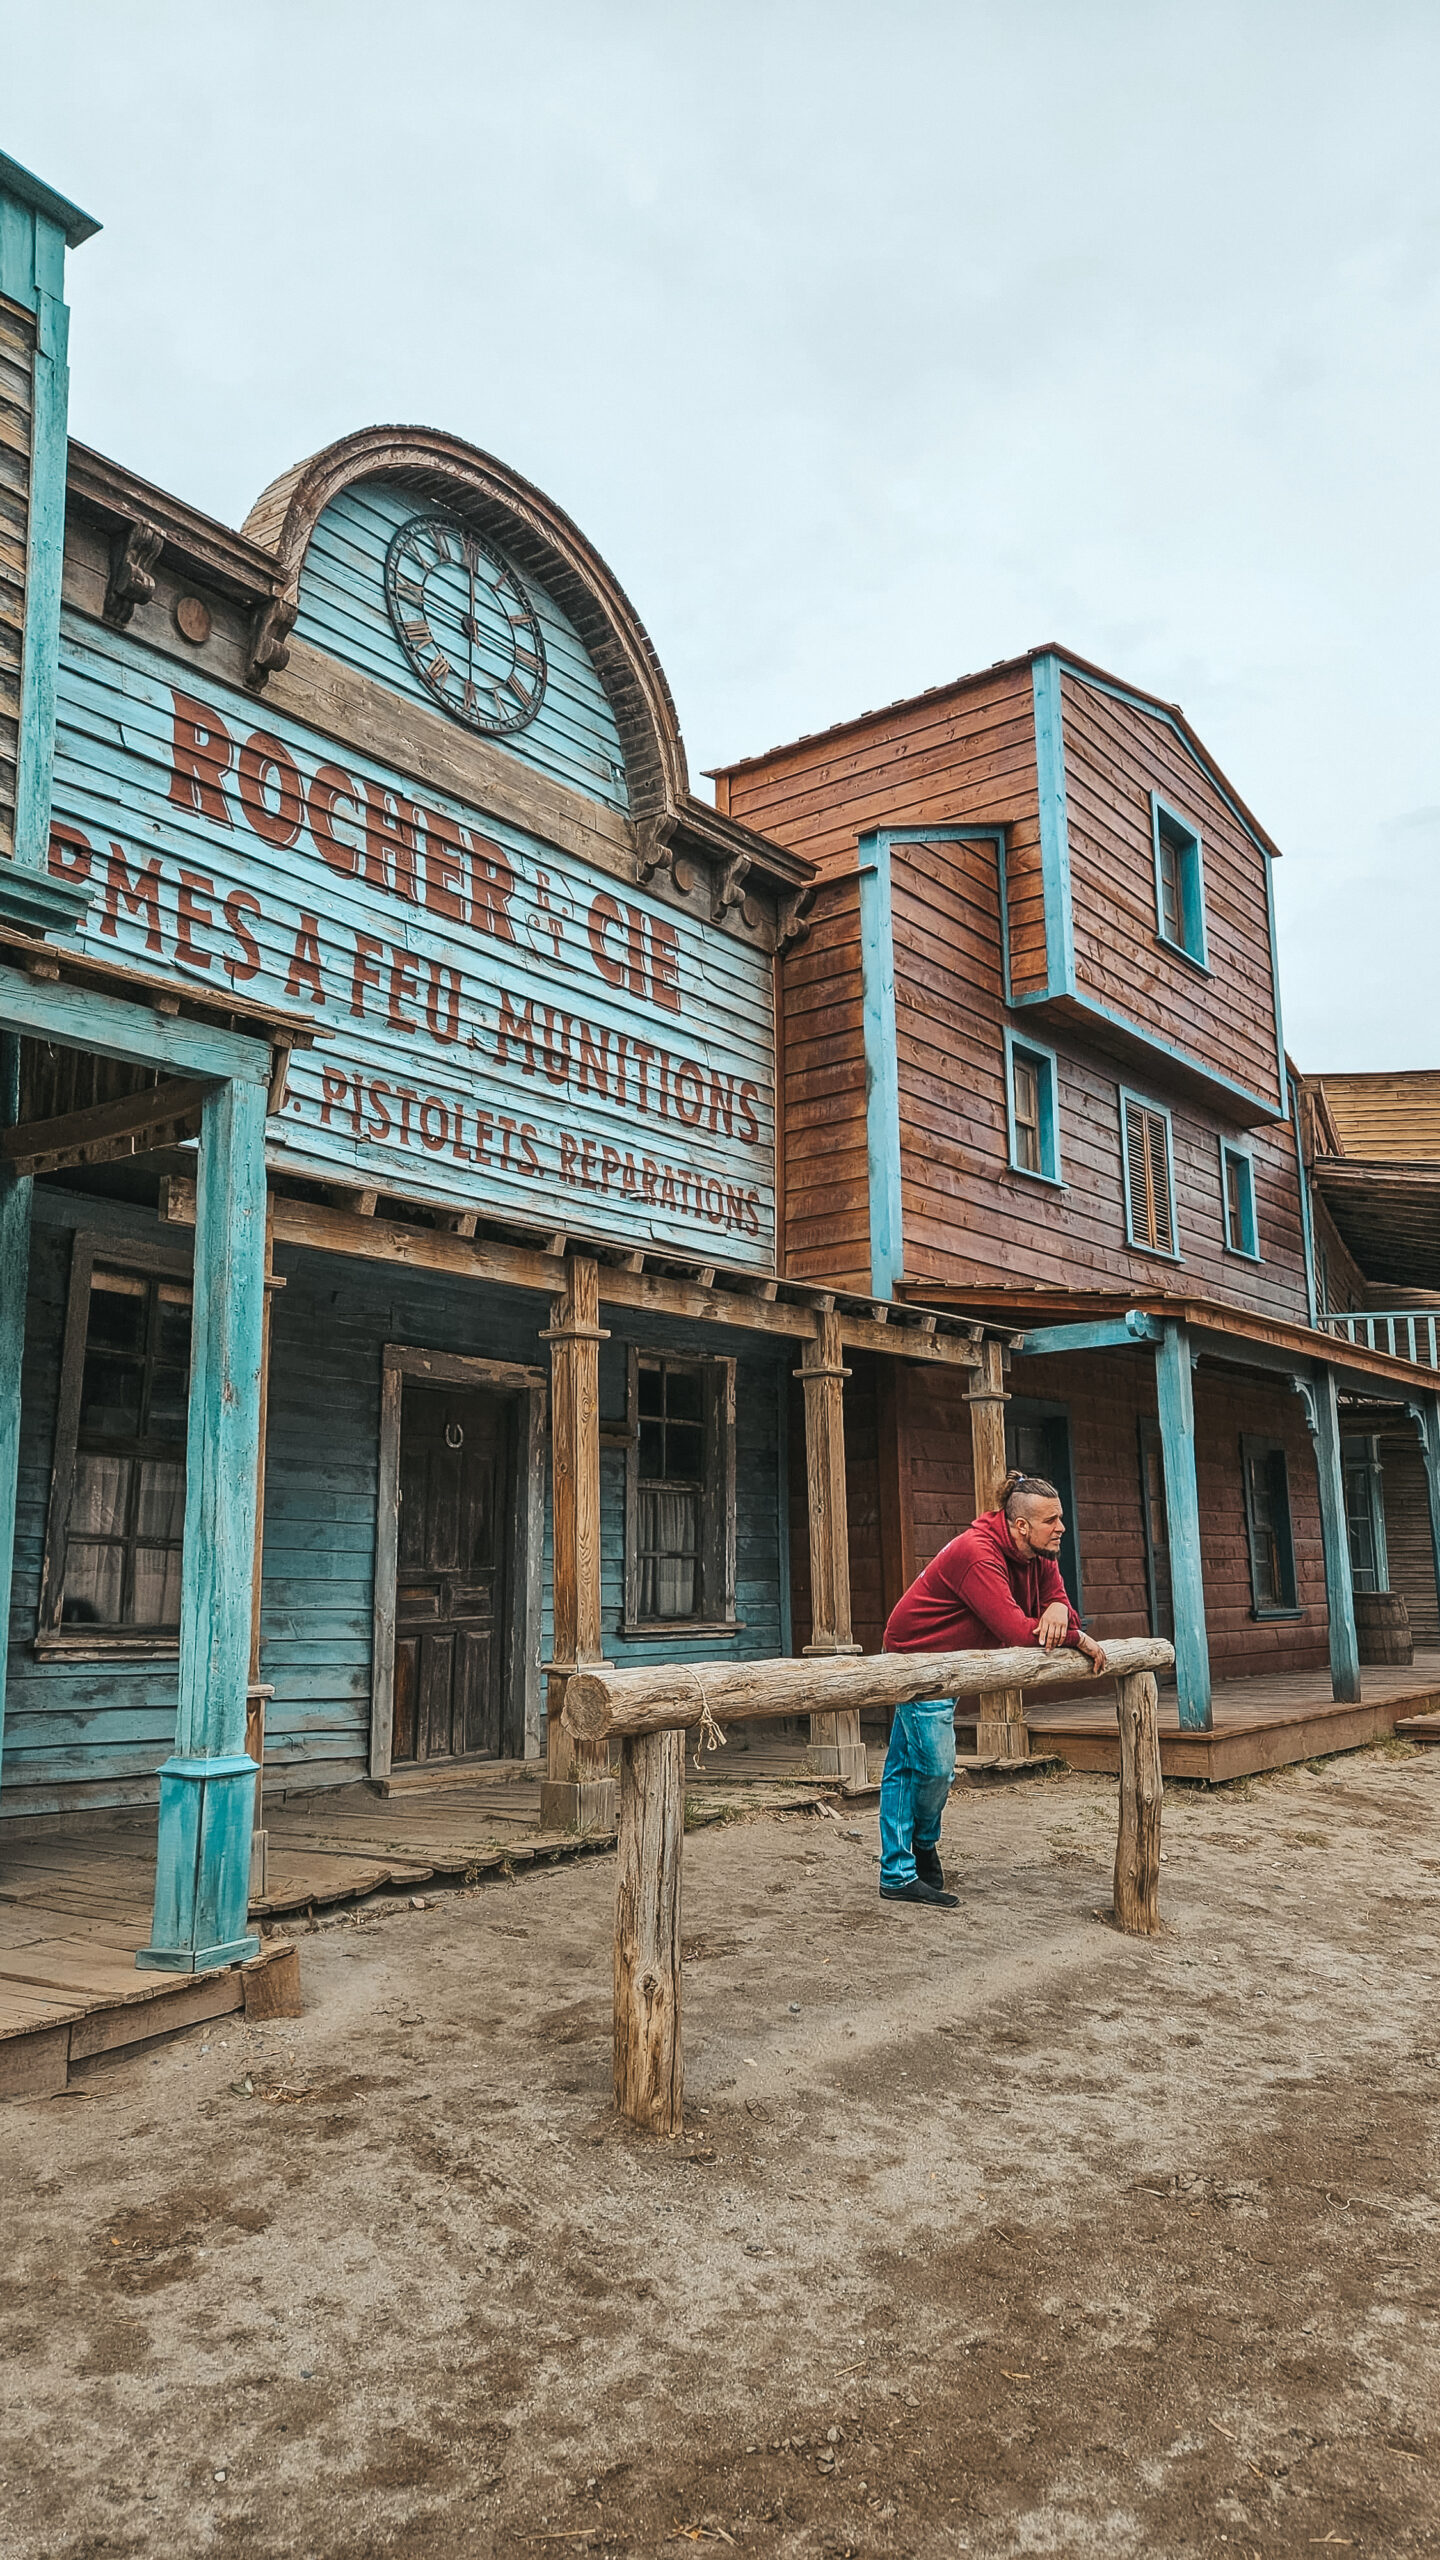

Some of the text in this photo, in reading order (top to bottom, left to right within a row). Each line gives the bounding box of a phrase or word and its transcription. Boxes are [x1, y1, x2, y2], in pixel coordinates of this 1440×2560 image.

[168, 690, 518, 948] ROCHER
[588, 893, 682, 1016] CIE
[284, 912, 326, 1006] A
[493, 989, 760, 1147] MUNITIONS
[559, 1131, 761, 1237] REPARATIONS
